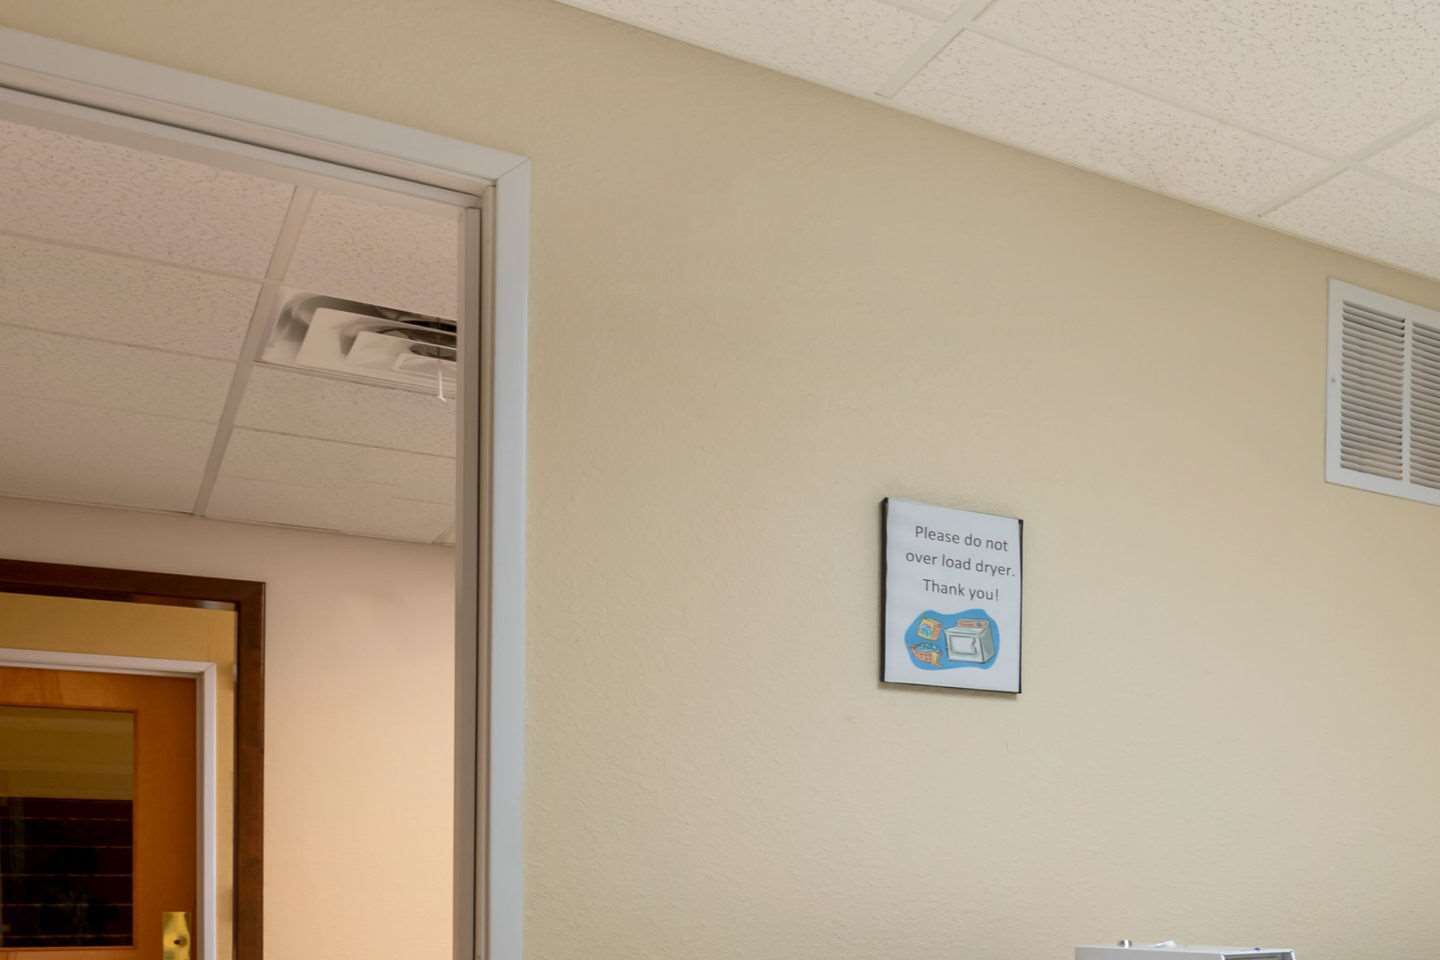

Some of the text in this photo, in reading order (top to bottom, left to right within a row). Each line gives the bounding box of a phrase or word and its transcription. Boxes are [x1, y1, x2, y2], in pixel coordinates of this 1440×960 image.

[915, 526, 1009, 552] Please do not
[905, 551, 1015, 577] over load dryer.
[922, 578, 999, 601] Thank you!
